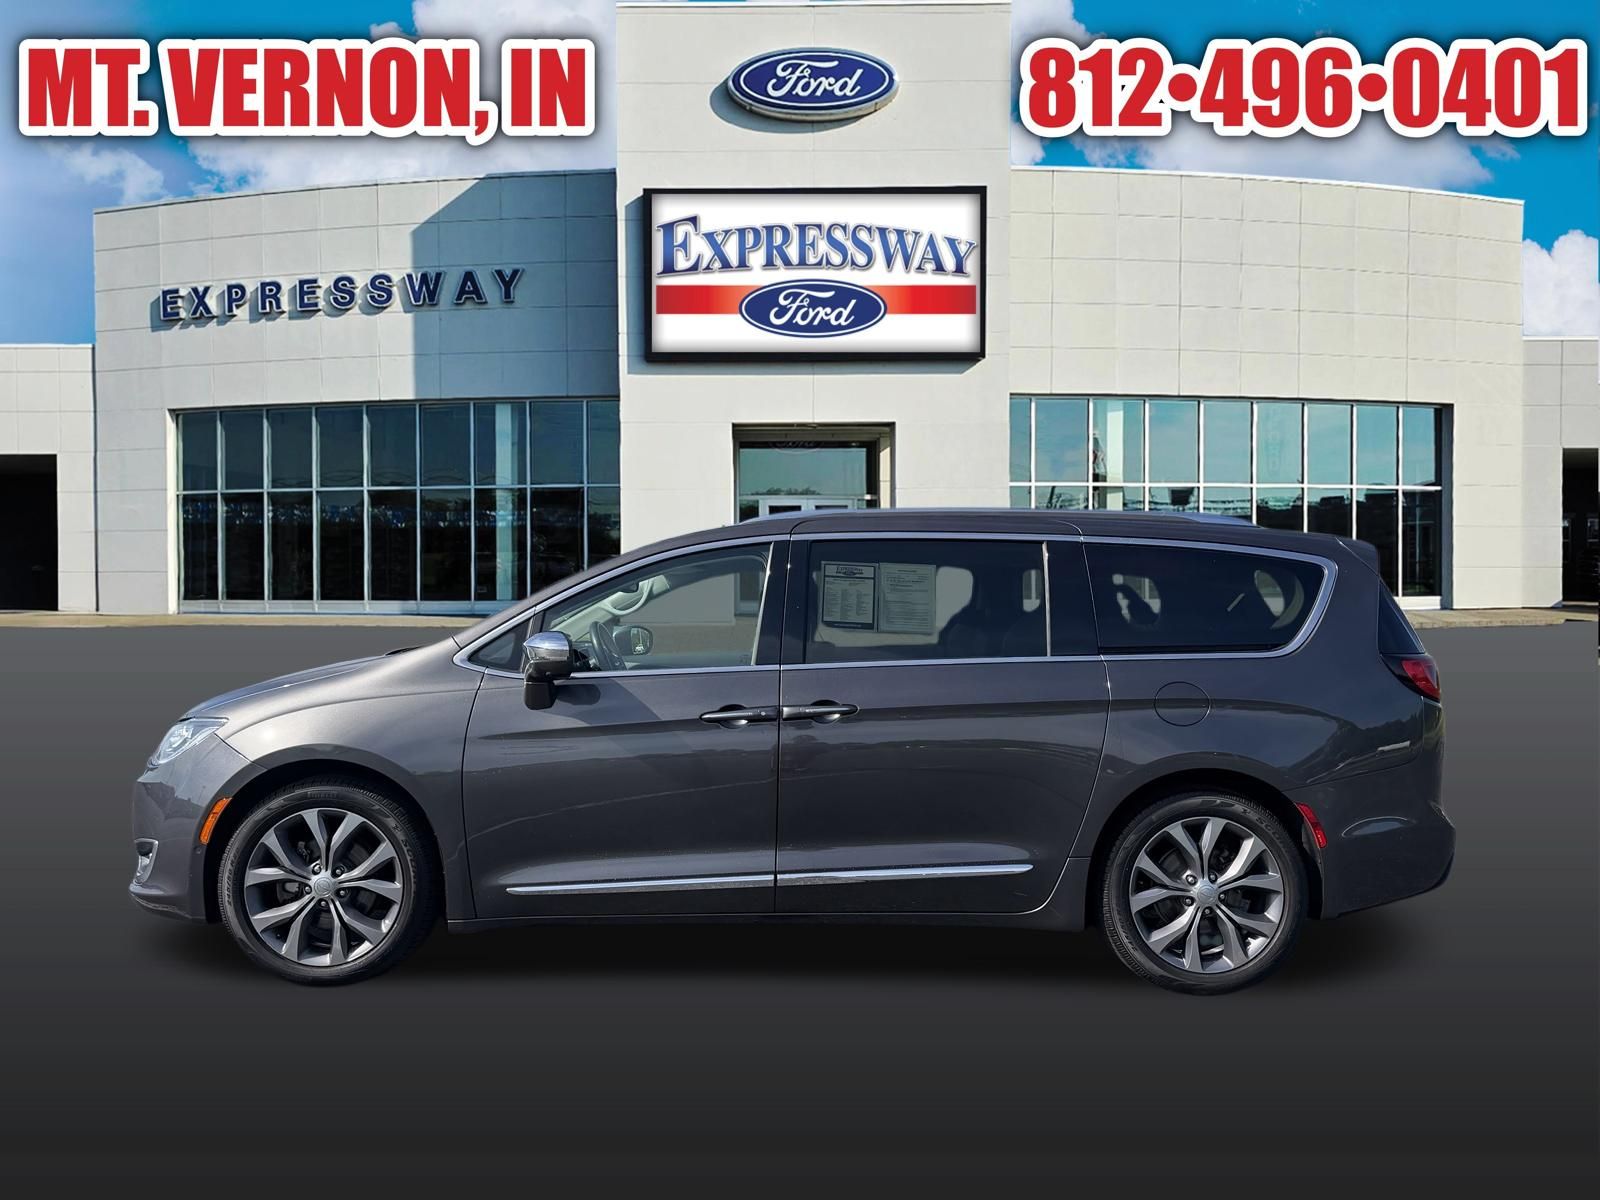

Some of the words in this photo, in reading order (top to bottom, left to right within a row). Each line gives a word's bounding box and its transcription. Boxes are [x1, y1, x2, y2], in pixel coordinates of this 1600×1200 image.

[766, 59, 864, 98] Ford
[655, 214, 977, 278] EXPRESSWAY
[159, 267, 524, 321] EXPRESSWAY
[769, 288, 858, 326] Ford
